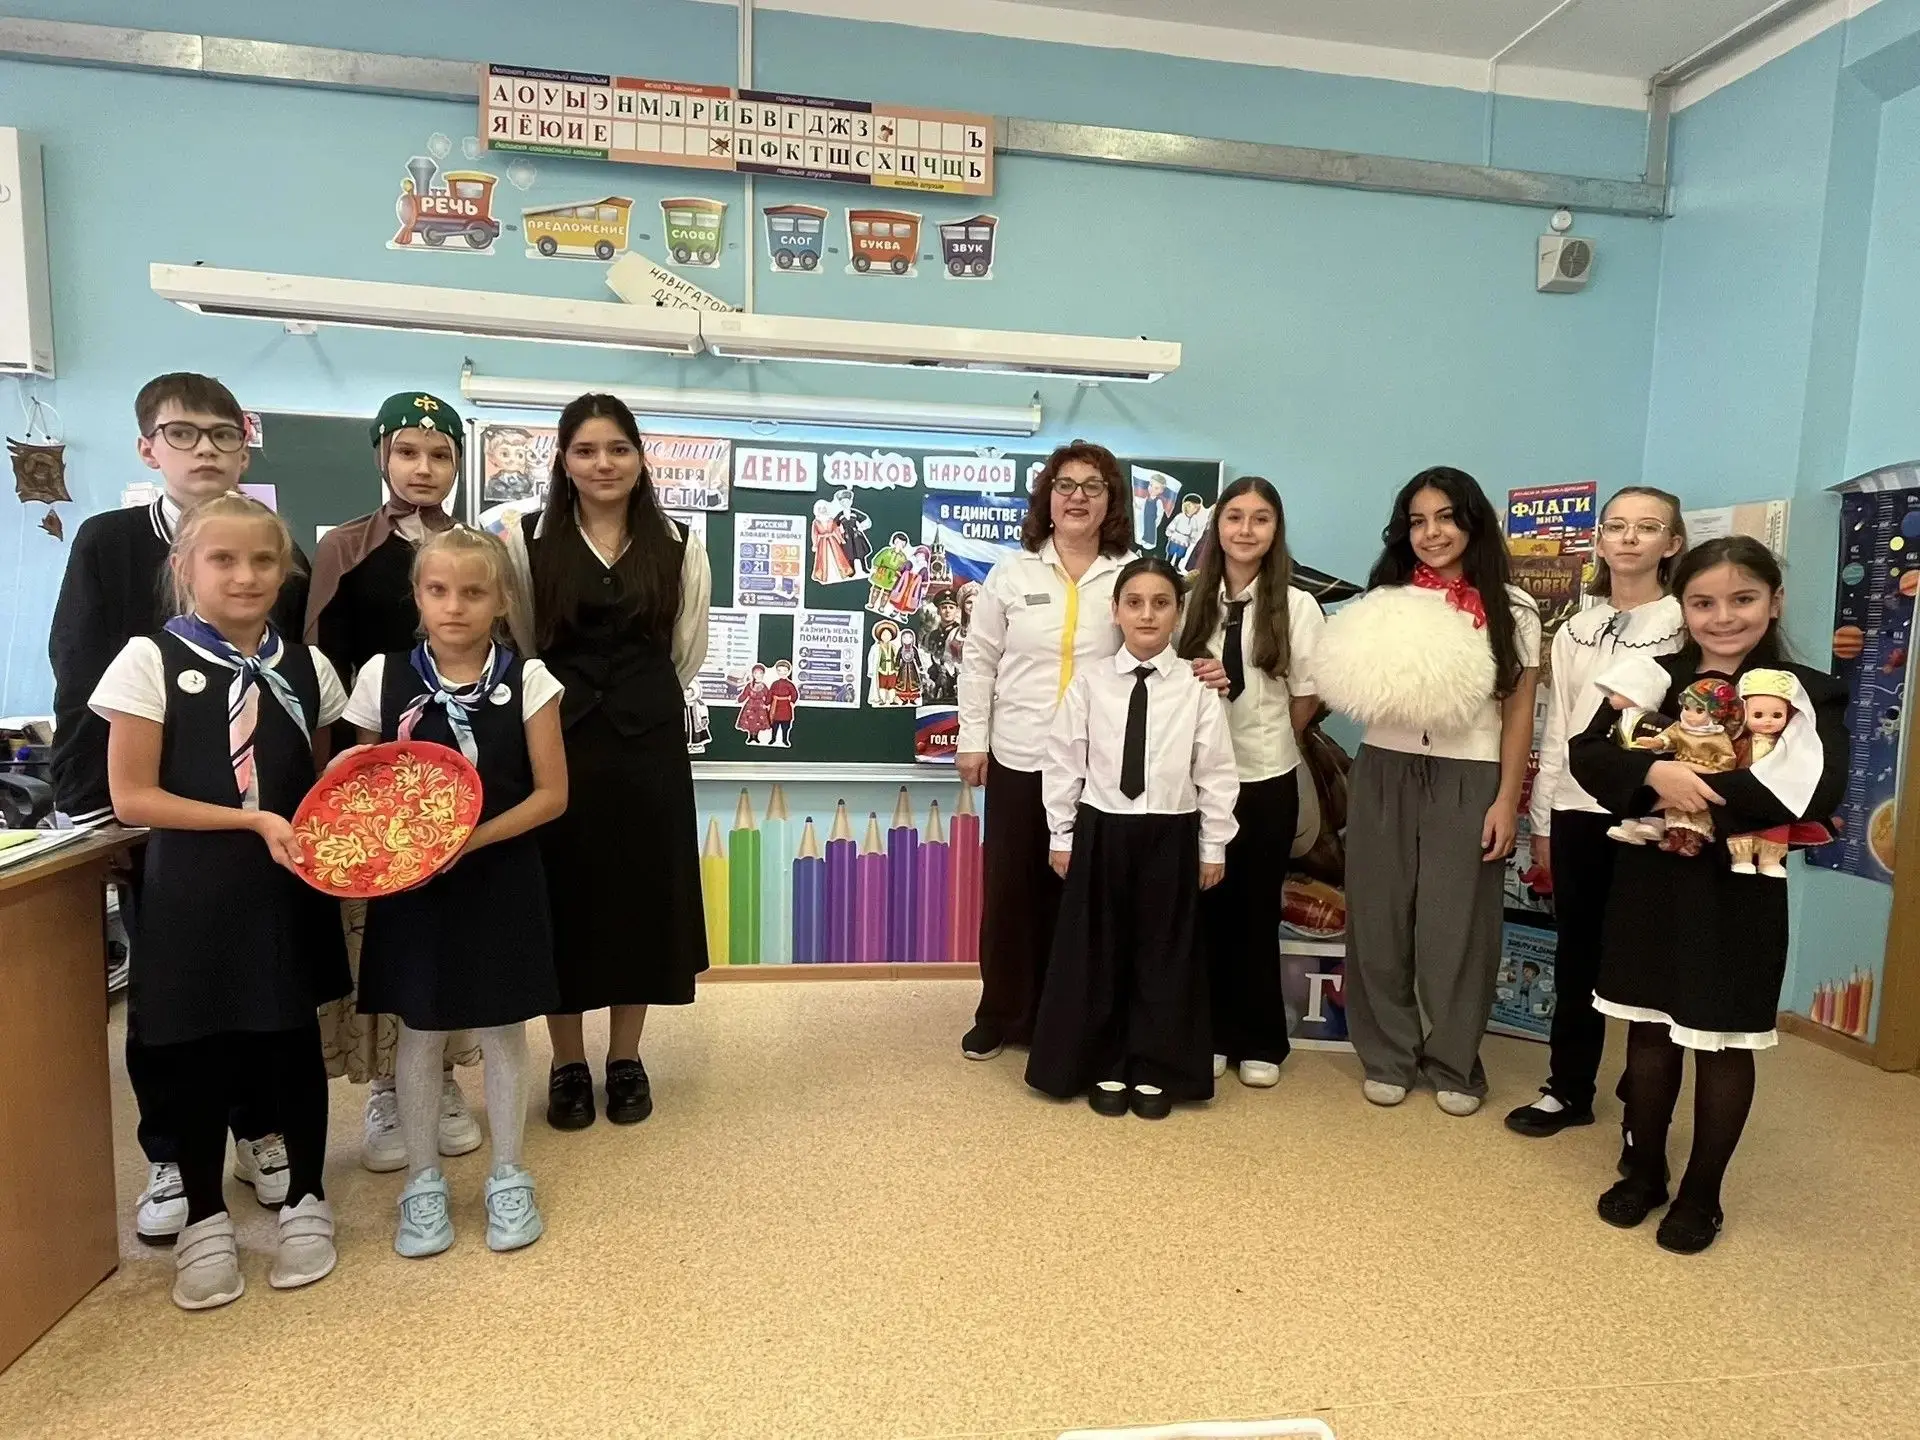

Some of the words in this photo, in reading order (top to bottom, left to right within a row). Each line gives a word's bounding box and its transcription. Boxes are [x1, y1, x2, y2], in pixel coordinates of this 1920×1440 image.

[421, 197, 479, 216] РЕЧЬ
[528, 220, 625, 235] ПРЕДЛОЖЕНИЕ
[671, 229, 716, 241] СЛОВО
[780, 235, 812, 246] СЛОГ
[860, 239, 901, 250] БУКВА
[952, 243, 984, 253] ЗВУК
[741, 455, 808, 483] ДЕНЬ
[831, 460, 912, 483] ЯЗЫКОВ
[929, 464, 1012, 483] НАРОДОВ
[940, 504, 950, 519] В
[953, 505, 1018, 522] ЕДИНСТВЕ
[1511, 496, 1591, 518] ФЛАГИ
[1536, 515, 1565, 525] МИРА
[962, 522, 1000, 539] СИЛА
[755, 544, 768, 555] 33
[800, 634, 859, 644] ПОМИЛОВАТЬ
[930, 734, 948, 746] ГОД
